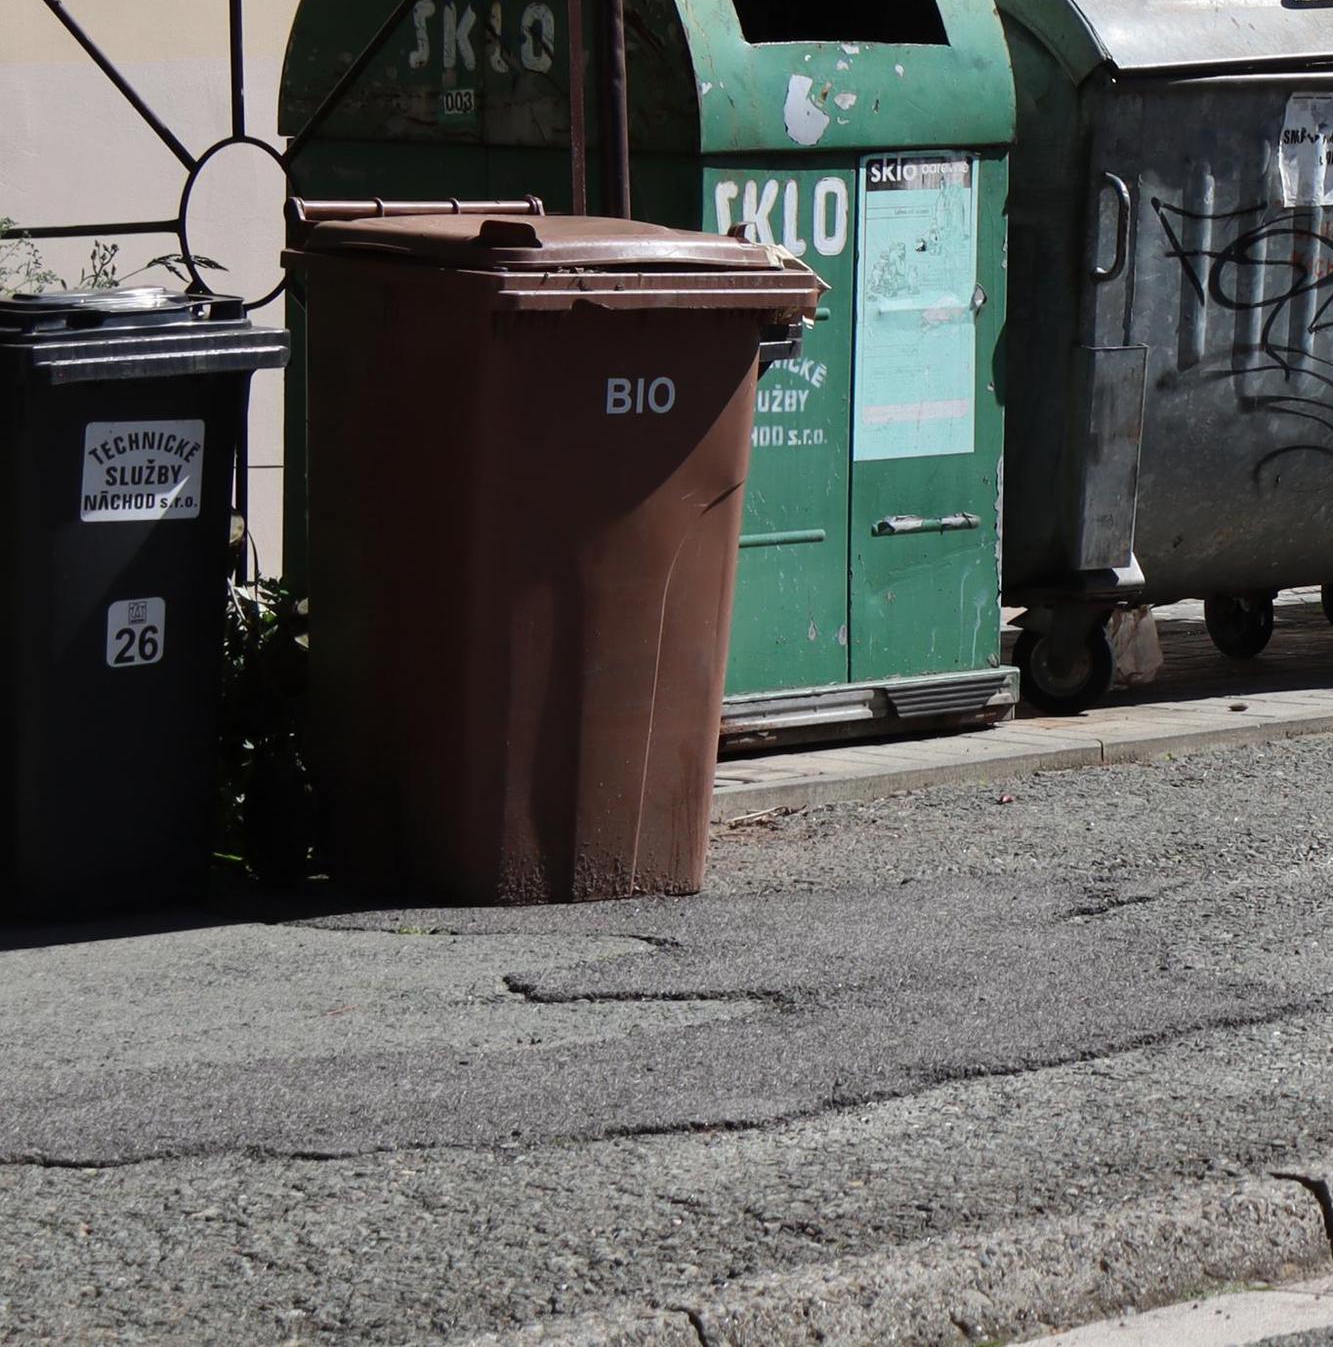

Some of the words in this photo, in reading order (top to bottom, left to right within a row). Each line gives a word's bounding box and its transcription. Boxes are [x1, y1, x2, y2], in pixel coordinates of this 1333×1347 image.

[445, 93, 473, 114] 003
[714, 177, 849, 257] SKLO
[769, 357, 828, 388] ICKÉ
[605, 376, 676, 415] BIO
[755, 384, 809, 413] UŽBY
[787, 428, 828, 446] s.r.o.
[105, 458, 183, 487] SLUŽBY
[83, 491, 155, 512] NÁCHOD
[160, 495, 198, 510] s.r.o.
[113, 624, 160, 665] 26
